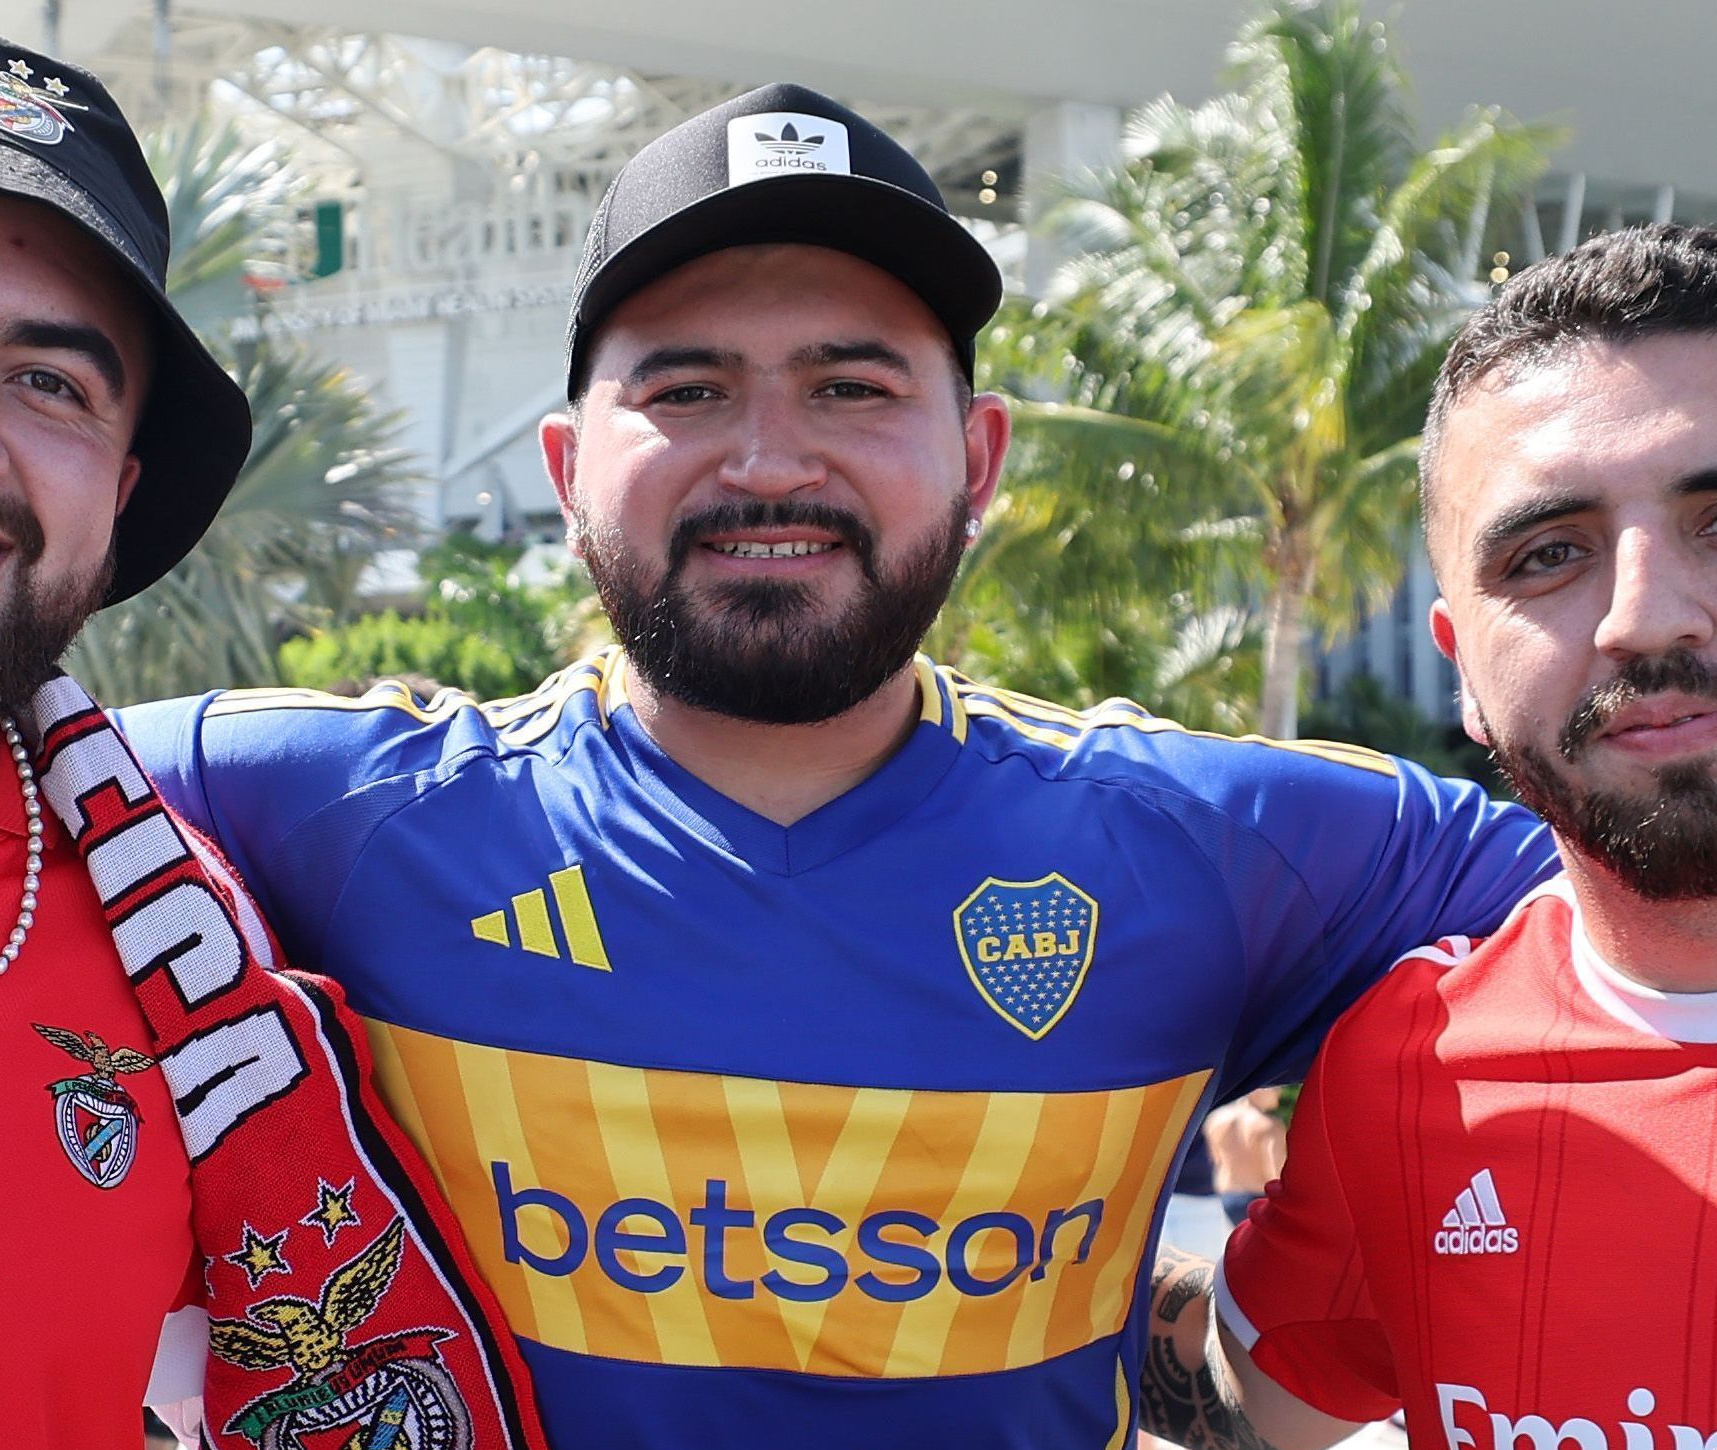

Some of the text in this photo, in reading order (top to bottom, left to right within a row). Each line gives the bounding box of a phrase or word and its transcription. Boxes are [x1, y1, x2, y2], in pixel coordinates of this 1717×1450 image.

[755, 157, 827, 171] adidas
[977, 929, 1081, 963] CABJ
[490, 1161, 1104, 1302] betsson
[1434, 1222, 1519, 1255] adidas
